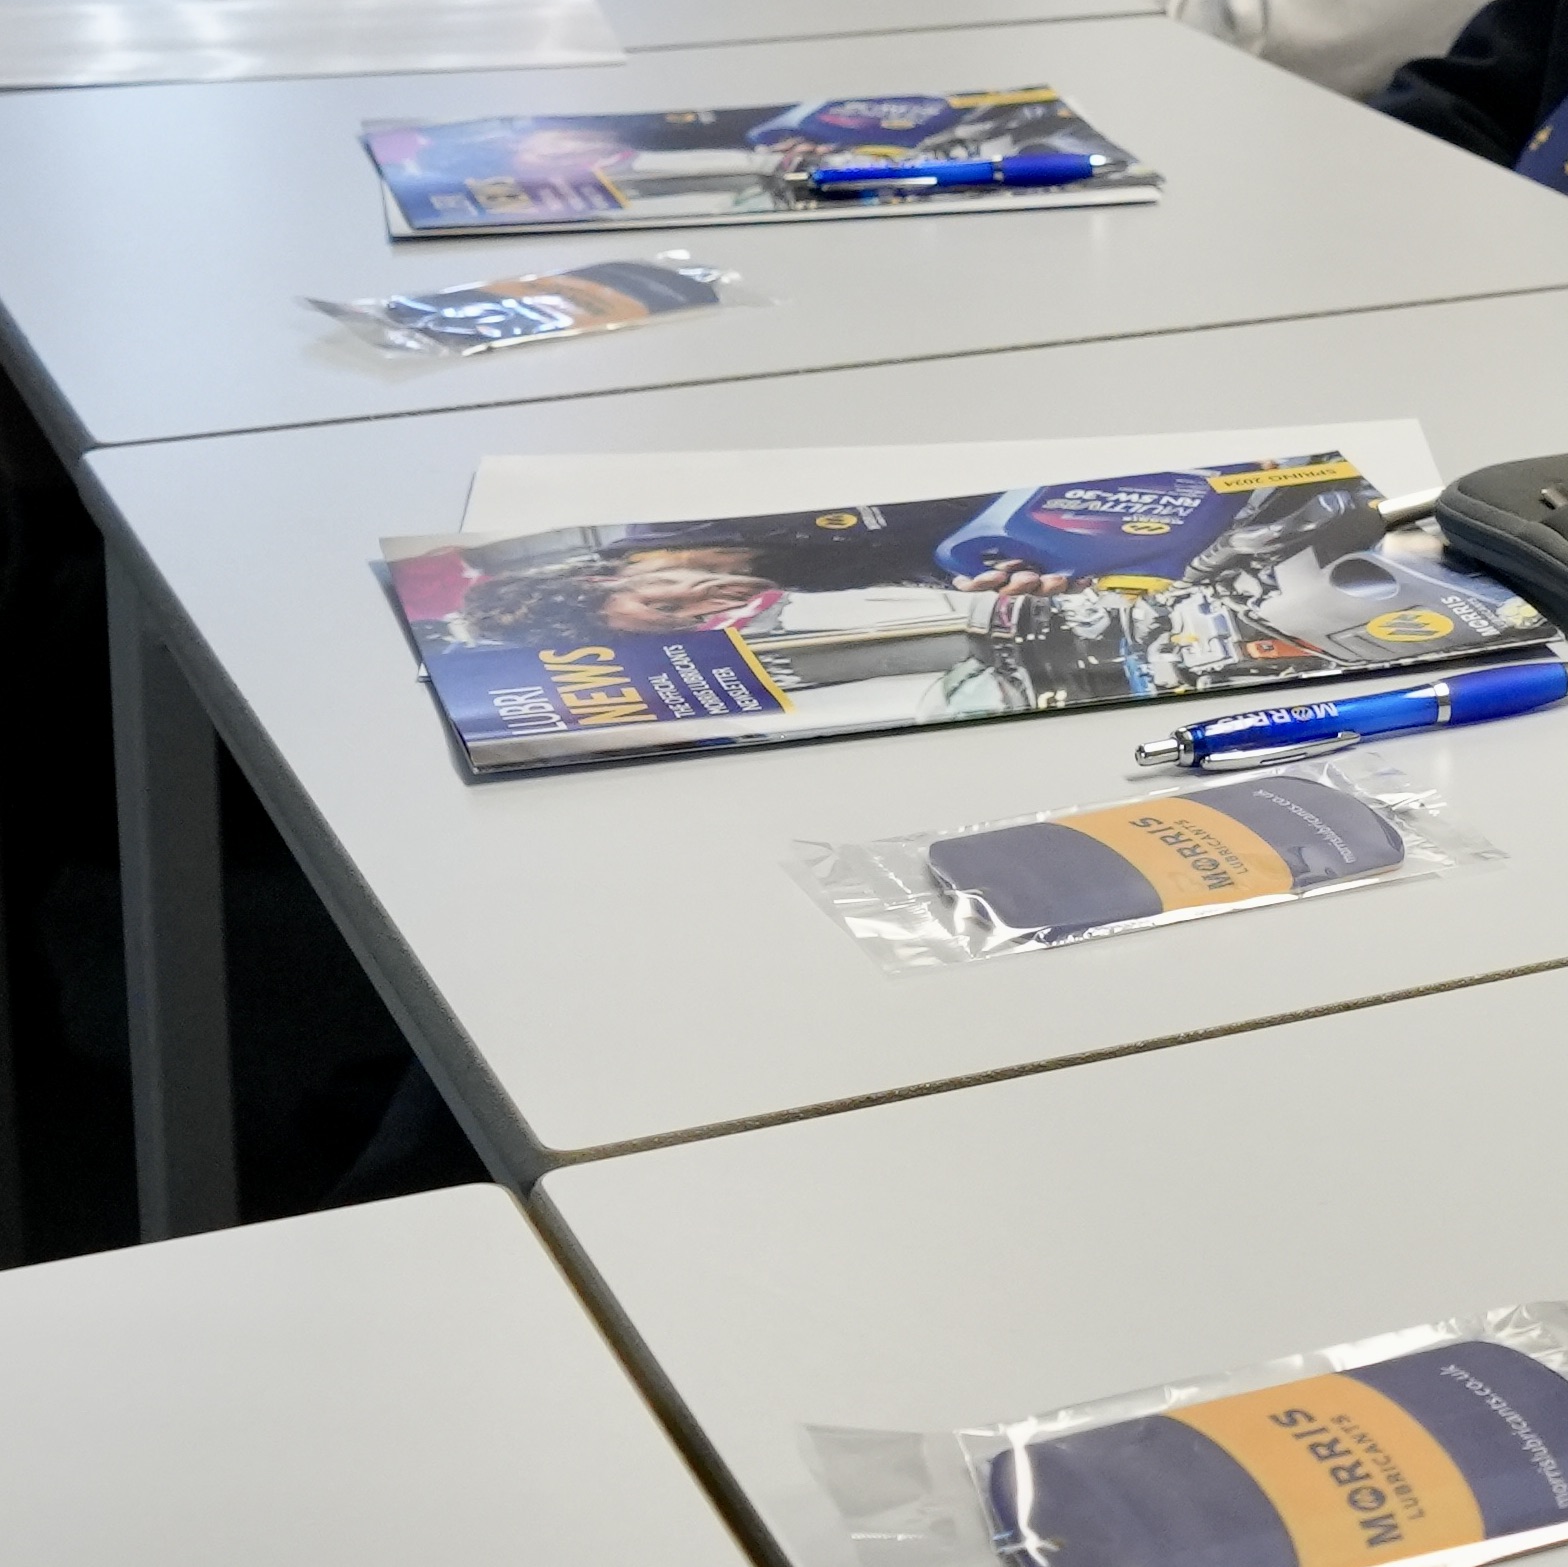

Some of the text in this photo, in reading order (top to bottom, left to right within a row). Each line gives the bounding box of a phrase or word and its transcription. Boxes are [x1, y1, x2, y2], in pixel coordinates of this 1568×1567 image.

[1158, 494, 1202, 508] RN
[1441, 595, 1501, 637] MORRIS
[488, 685, 570, 736] LUBRI
[538, 645, 659, 725] NEWS
[1128, 816, 1236, 892] MORRIS
[1173, 818, 1249, 876] LUBRICANTS
[1252, 788, 1357, 865] morrislubricants.co.uk
[1267, 1407, 1403, 1549] MORRIS
[1329, 1413, 1426, 1521] LUBRICANTS
